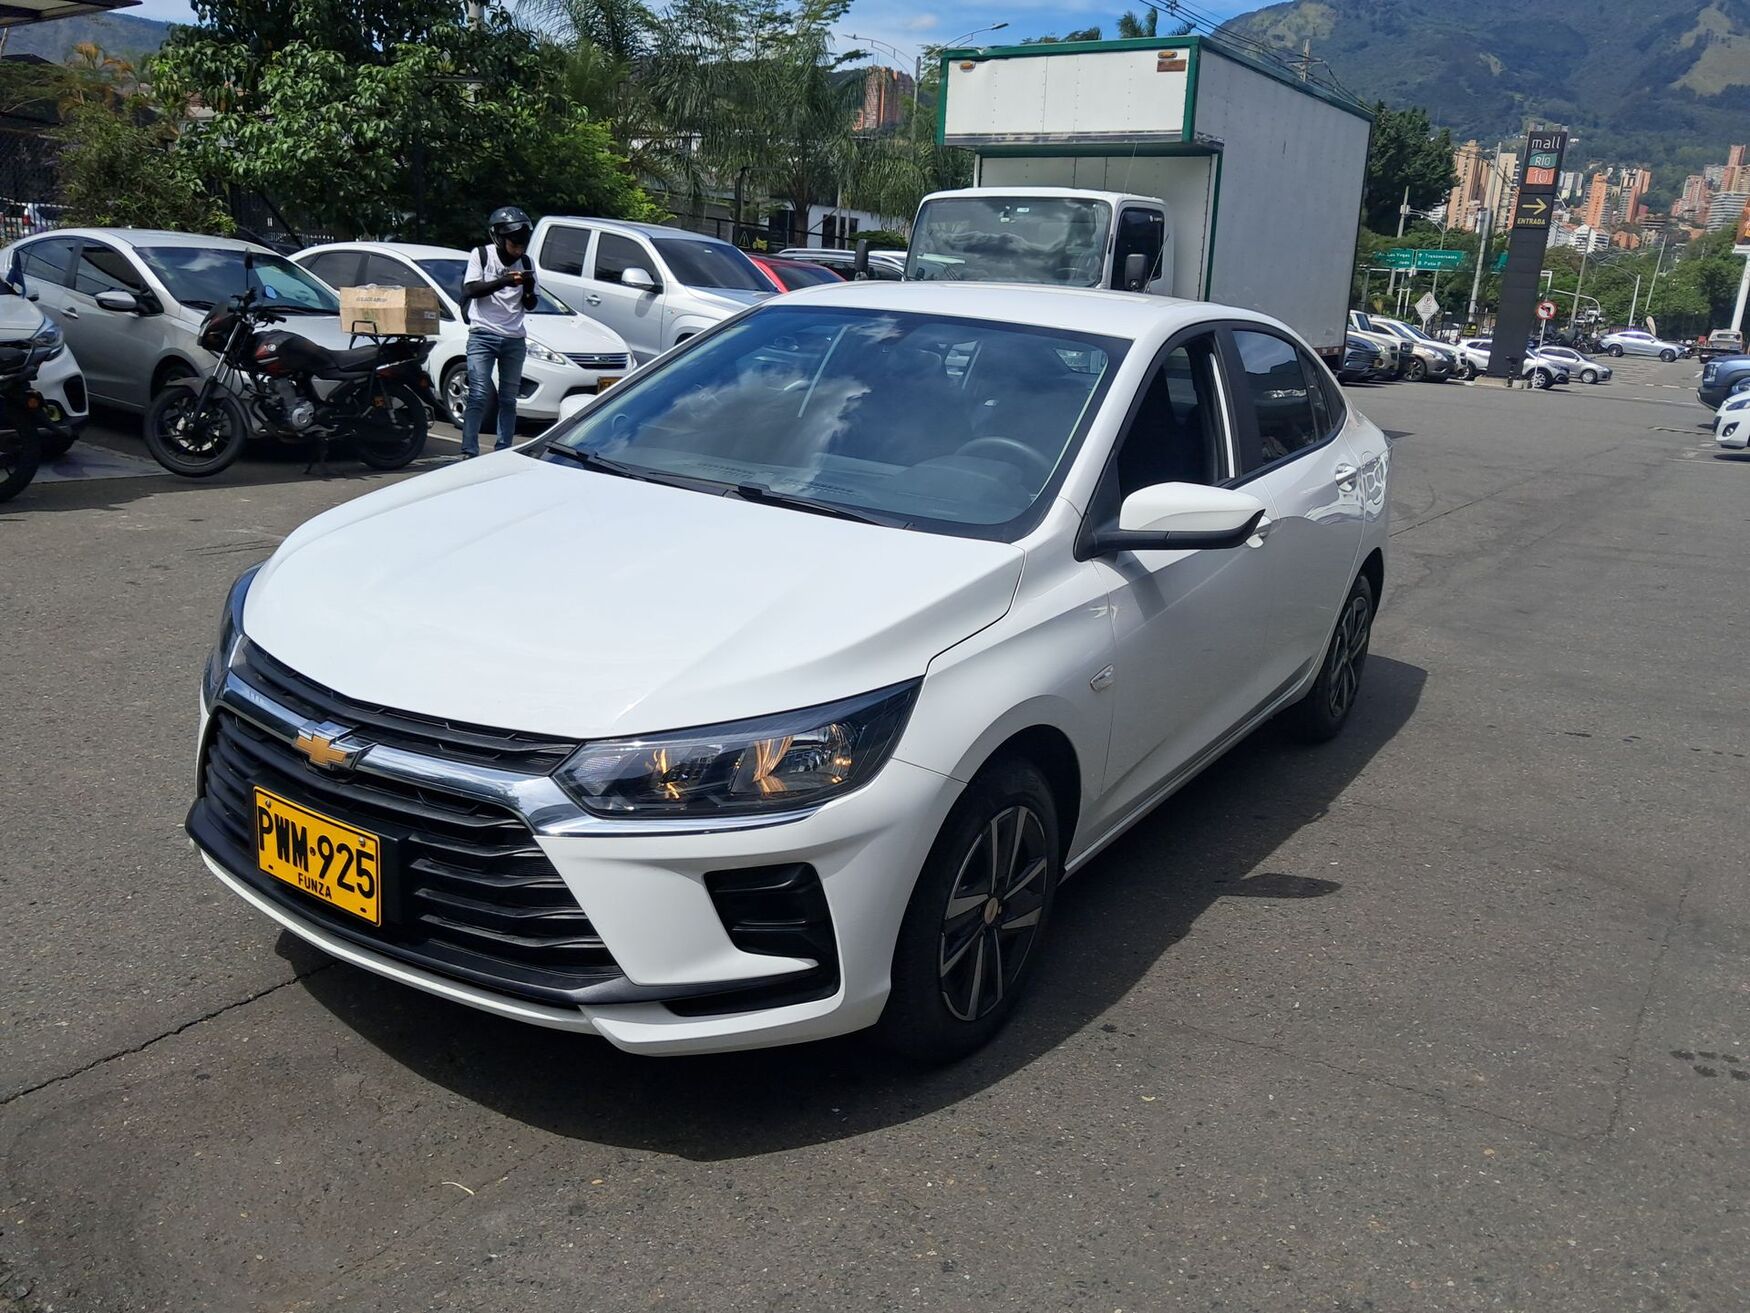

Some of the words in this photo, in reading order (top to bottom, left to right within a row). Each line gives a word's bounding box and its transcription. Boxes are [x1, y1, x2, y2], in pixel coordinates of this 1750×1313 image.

[1531, 136, 1560, 149] mall
[1534, 170, 1549, 184] 10
[1517, 217, 1546, 225] ENTRADA
[298, 872, 333, 900] FUNZA
